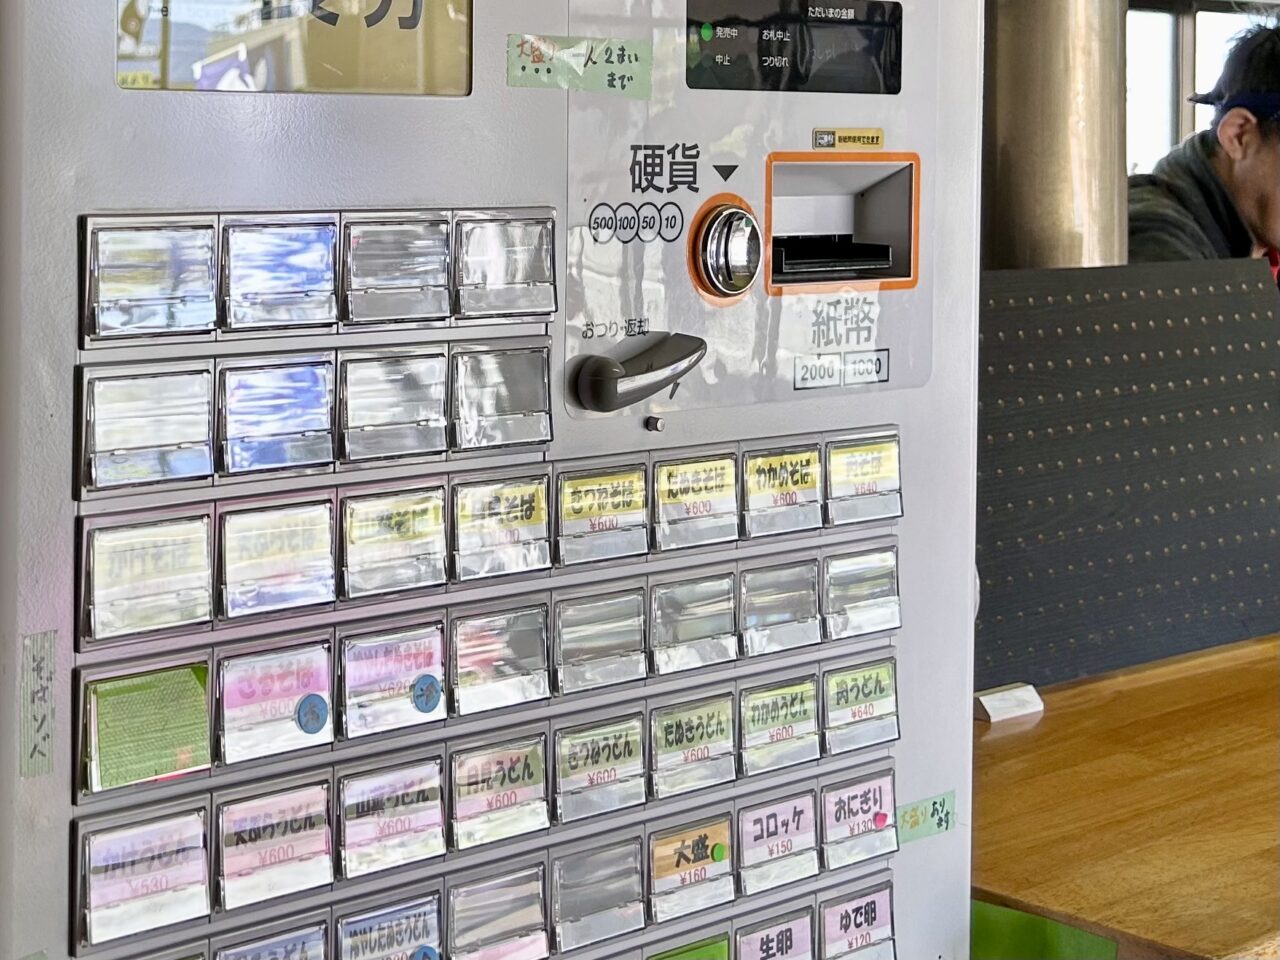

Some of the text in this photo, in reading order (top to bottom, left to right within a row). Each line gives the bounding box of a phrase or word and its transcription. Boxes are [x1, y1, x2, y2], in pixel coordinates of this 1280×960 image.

[716, 27, 790, 41] 発売中 お札中止
[808, 7, 855, 19] ただいまの金額
[607, 72, 633, 90] まで
[715, 54, 789, 67] 中止 つり切れ
[630, 143, 701, 193] 硬貨
[593, 214, 677, 231] 500 100 50 10
[811, 296, 875, 348] 紙幣
[801, 364, 834, 381] 2000
[756, 458, 811, 488] わかめそば
[589, 516, 619, 532] ¥600
[684, 499, 712, 516] ¥600
[772, 490, 797, 507] ¥600
[664, 710, 725, 748] たぬきうどん
[751, 691, 808, 726] わかめうどん
[587, 703, 875, 786] ¥600 ¥600 ¥600 ¥640
[258, 844, 295, 870] ¥600
[486, 791, 518, 810] ¥600
[752, 805, 804, 842] コロッケ
[834, 785, 883, 823] おにぎり
[679, 819, 873, 885] ¥160 ¥150 ¥130
[759, 927, 793, 960] 生卵
[839, 900, 877, 933] ゆで卵
[847, 932, 871, 950] ¥120
